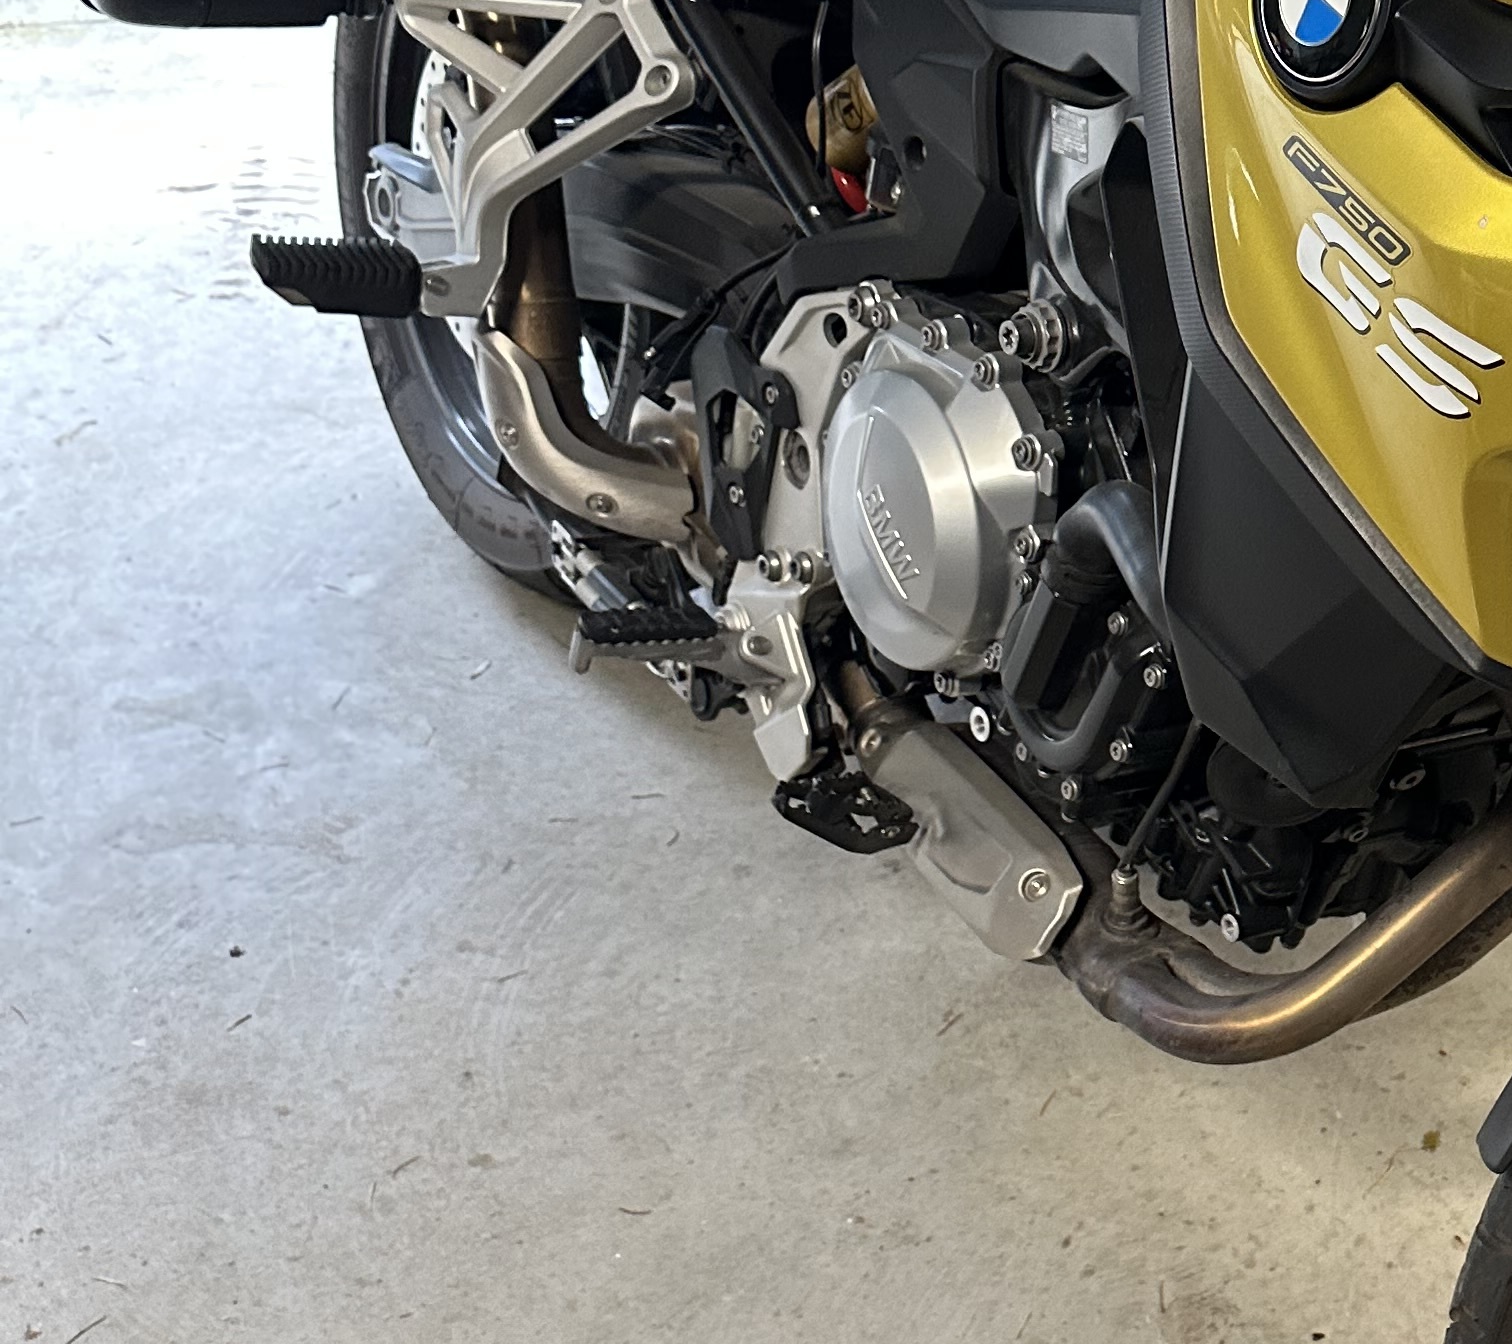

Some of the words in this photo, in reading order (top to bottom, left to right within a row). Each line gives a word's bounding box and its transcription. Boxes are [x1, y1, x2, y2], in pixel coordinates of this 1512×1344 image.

[1285, 139, 1406, 262] F750
[1296, 211, 1506, 420] GS
[864, 482, 921, 583] BMW
